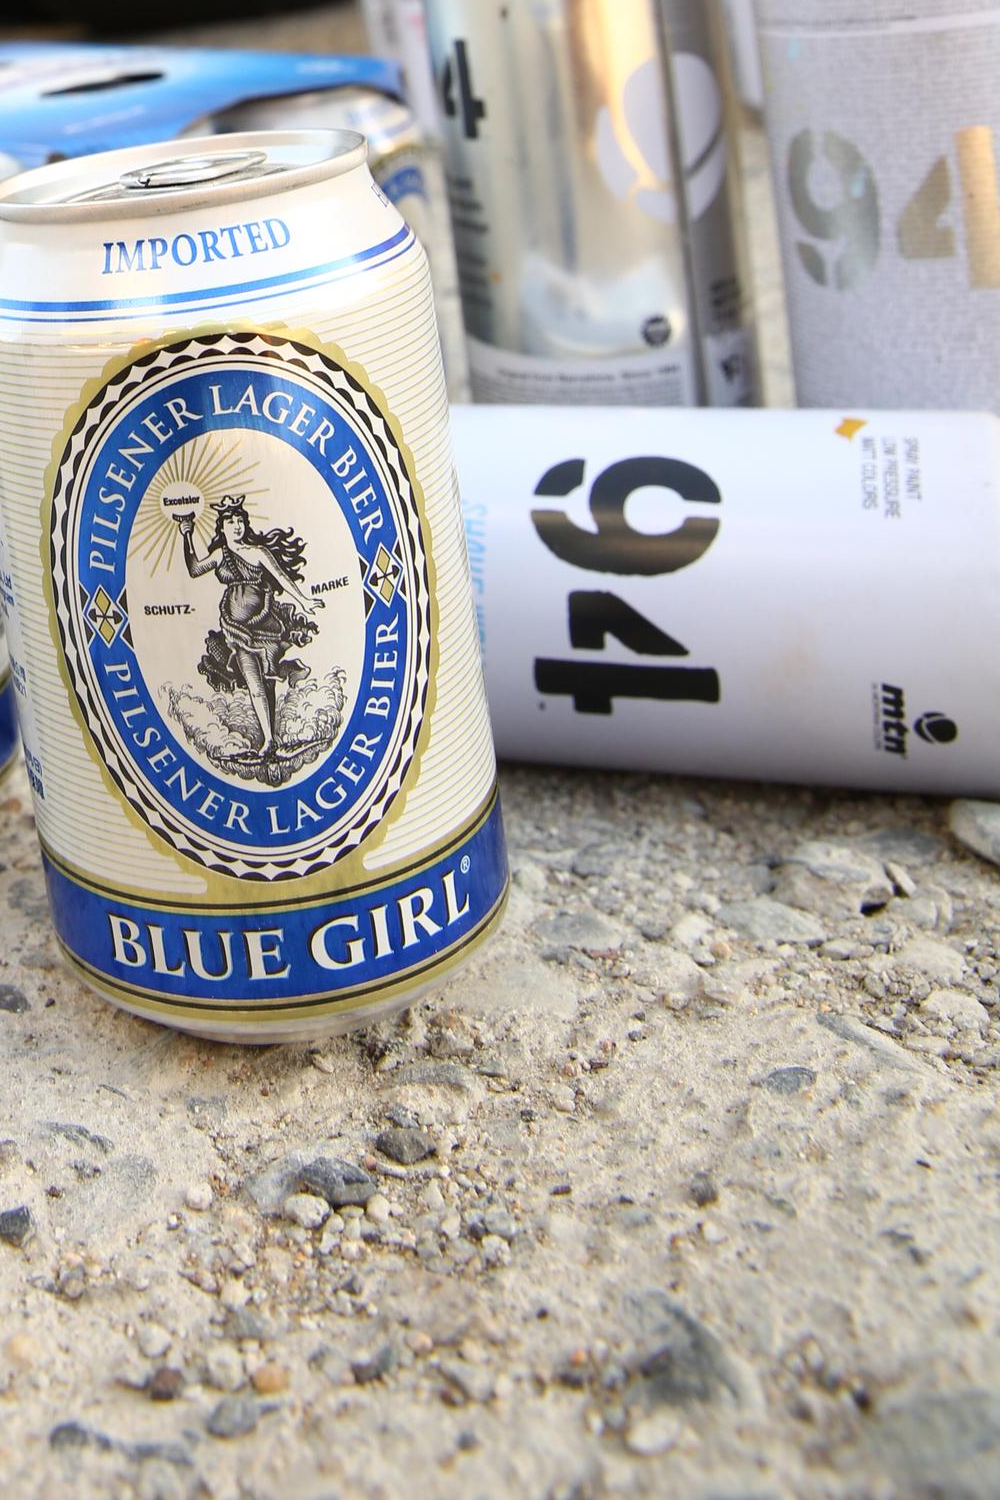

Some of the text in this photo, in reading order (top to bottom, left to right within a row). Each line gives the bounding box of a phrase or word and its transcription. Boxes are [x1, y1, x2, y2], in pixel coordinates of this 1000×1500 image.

[101, 216, 292, 276] IMPORTED
[787, 124, 1000, 292] 94
[87, 396, 204, 575] PILSENER
[207, 384, 338, 458] LAGER
[329, 444, 385, 542] BIER
[161, 494, 202, 507] Excelsior
[143, 604, 197, 618] SCHUTZ-
[310, 576, 350, 595] MARKE
[529, 456, 722, 716] 94
[103, 662, 253, 836] PILSENER
[265, 731, 385, 836] LAGER
[364, 612, 400, 720] BIER
[881, 682, 909, 758] mtn
[109, 870, 471, 981] BLUE GIRL
